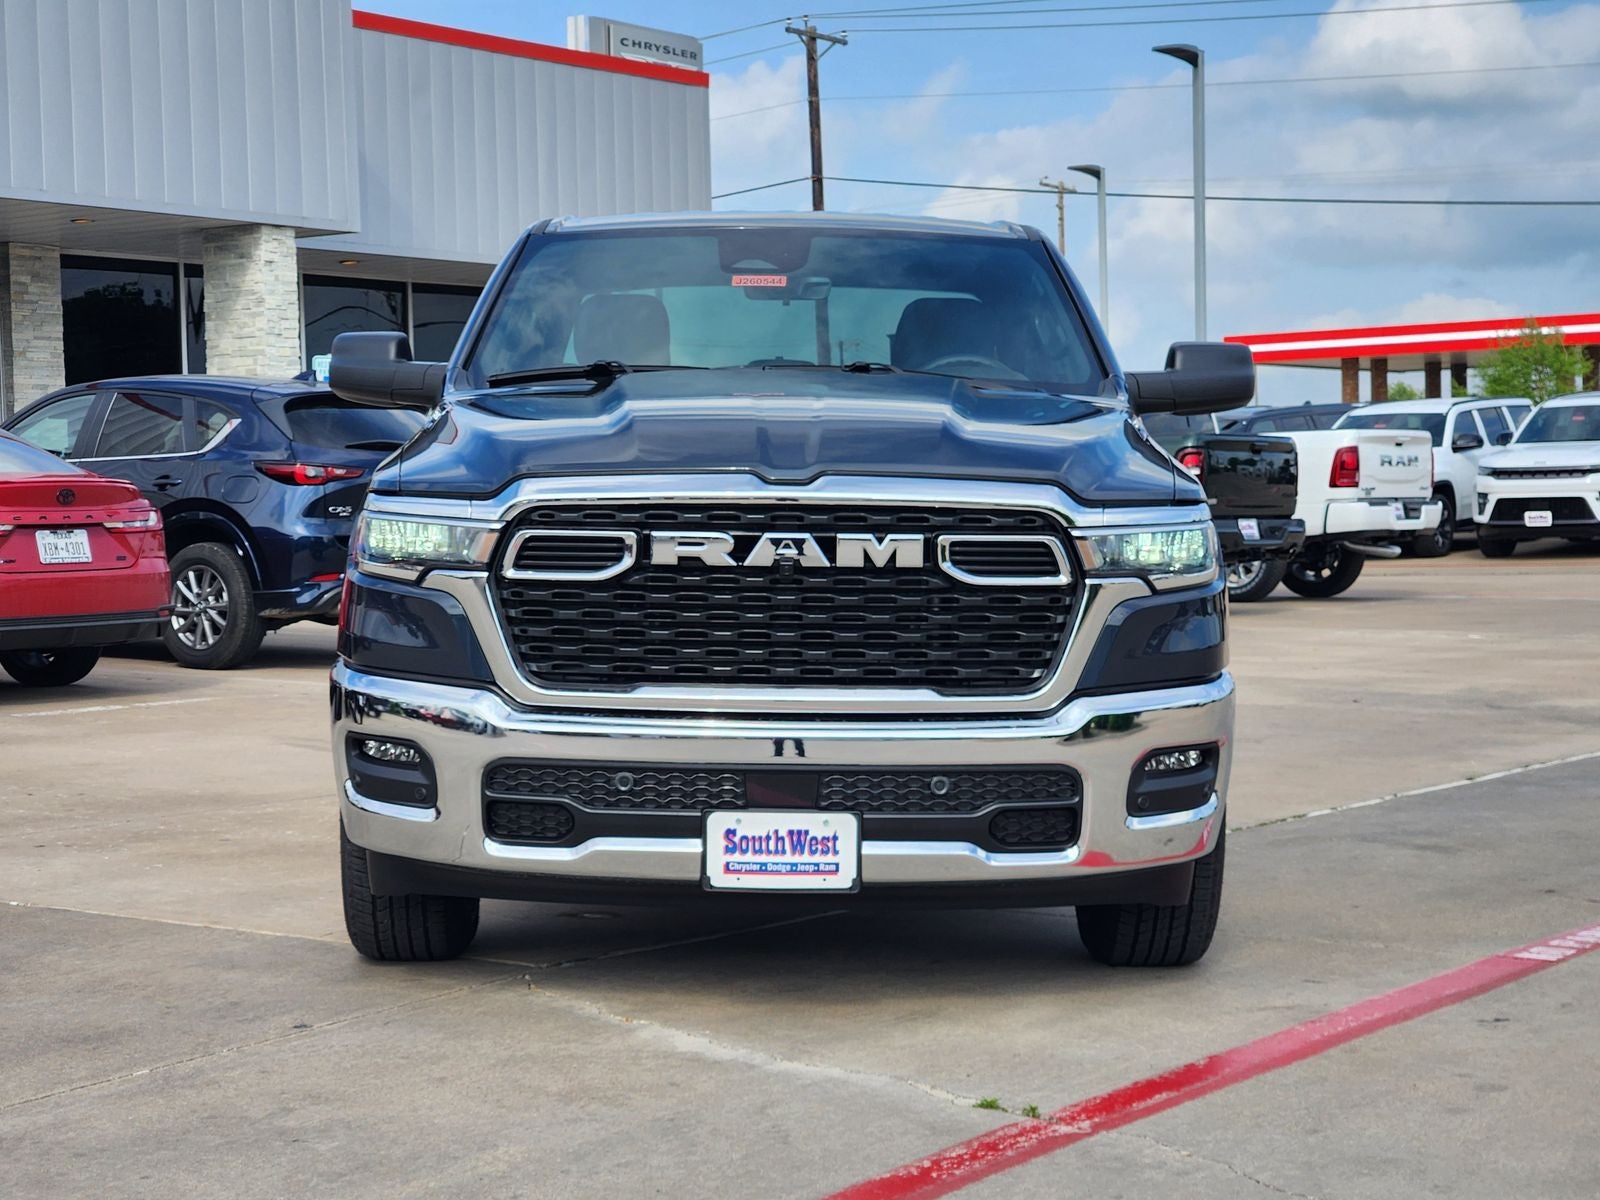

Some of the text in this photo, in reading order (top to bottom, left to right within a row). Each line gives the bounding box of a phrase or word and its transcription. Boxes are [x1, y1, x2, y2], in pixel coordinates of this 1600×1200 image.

[620, 37, 697, 60] CHRYSLER
[735, 277, 783, 285] J260544
[1380, 454, 1419, 467] RAM
[650, 530, 925, 568] RAM
[724, 828, 839, 857] SouthWest
[729, 862, 760, 872] Chrysler
[766, 862, 791, 872] Dodge
[819, 863, 836, 872] Ram
